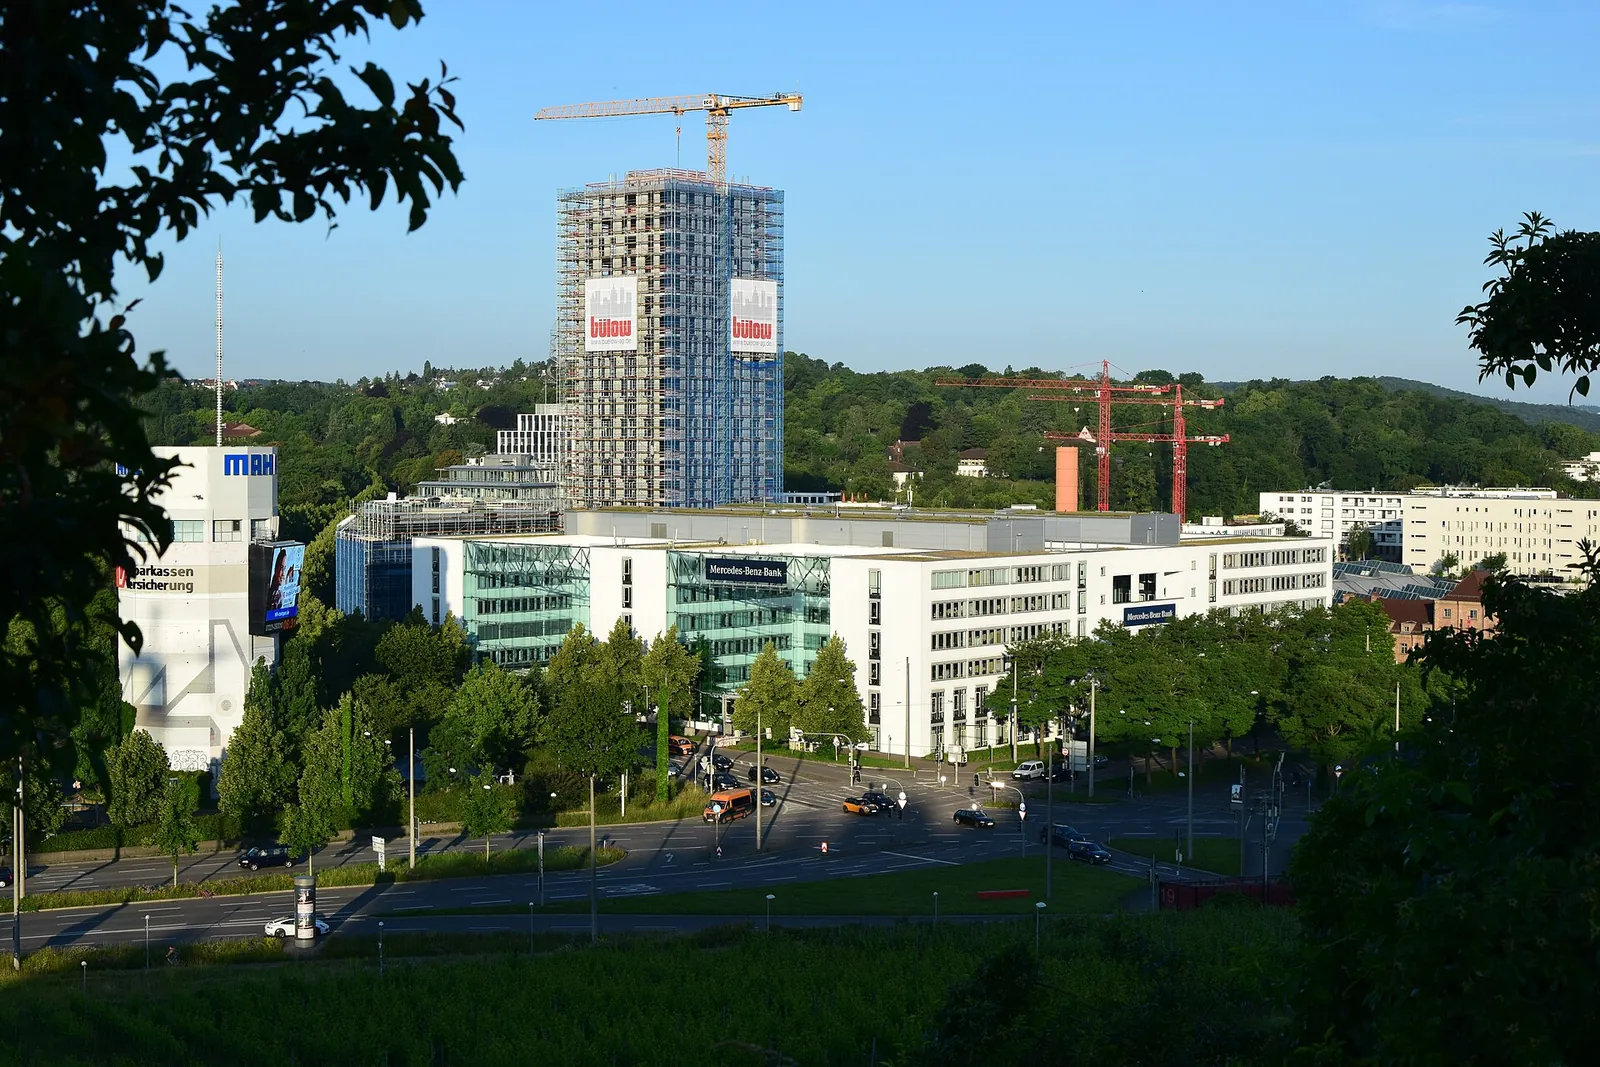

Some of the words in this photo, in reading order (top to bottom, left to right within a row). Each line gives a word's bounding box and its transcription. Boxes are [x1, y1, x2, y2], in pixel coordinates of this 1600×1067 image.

[590, 316, 632, 338] bülow
[733, 316, 772, 339] bülow
[710, 565, 763, 576] Mercedes-Benz
[763, 567, 783, 577] Bank
